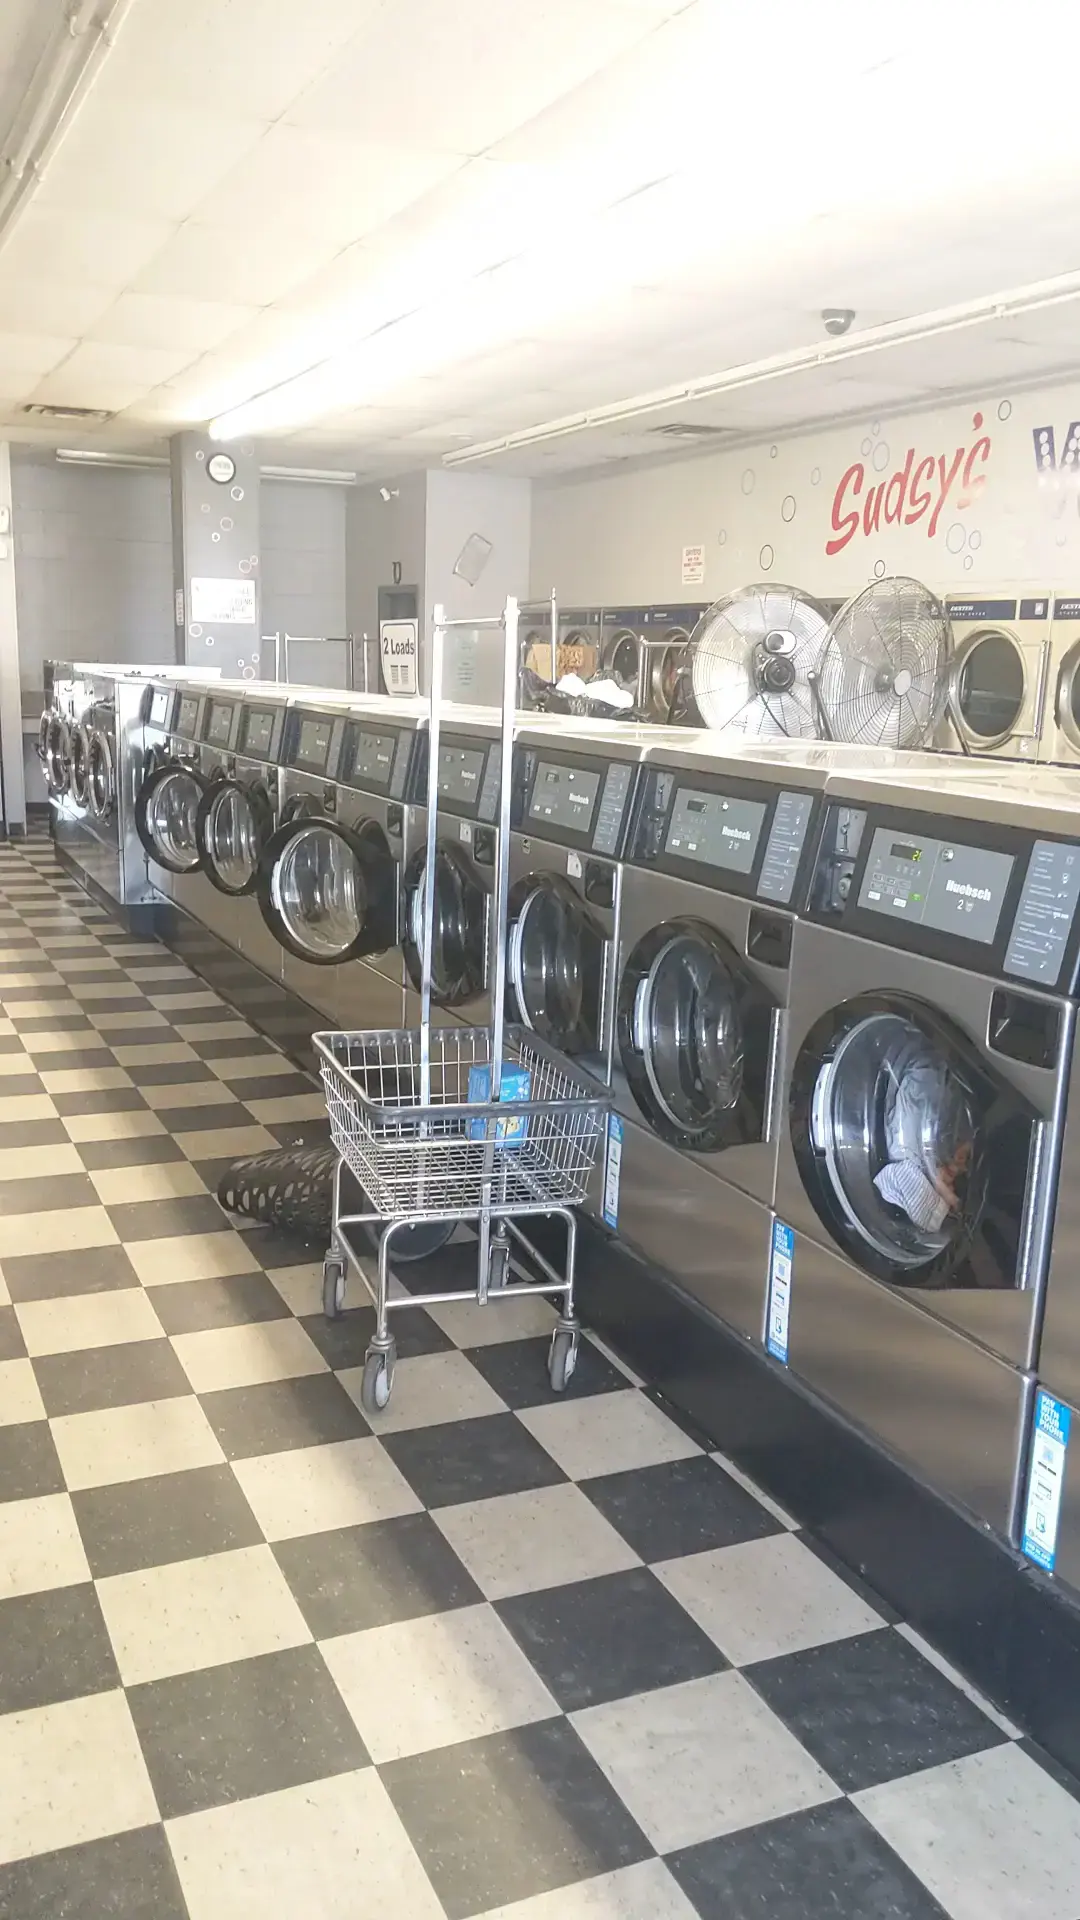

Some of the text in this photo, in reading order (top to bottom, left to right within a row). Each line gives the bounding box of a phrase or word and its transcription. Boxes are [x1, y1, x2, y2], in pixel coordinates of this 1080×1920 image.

[825, 412, 991, 556] Sudsy's
[383, 637, 415, 655] 2 Loads
[945, 879, 992, 902] Huebsch
[956, 899, 964, 910] 2
[1041, 1395, 1056, 1409] PAY
[1040, 1410, 1060, 1428] YOUR
[1041, 1403, 1060, 1420] WITH
[1039, 1419, 1065, 1440] PHONE
